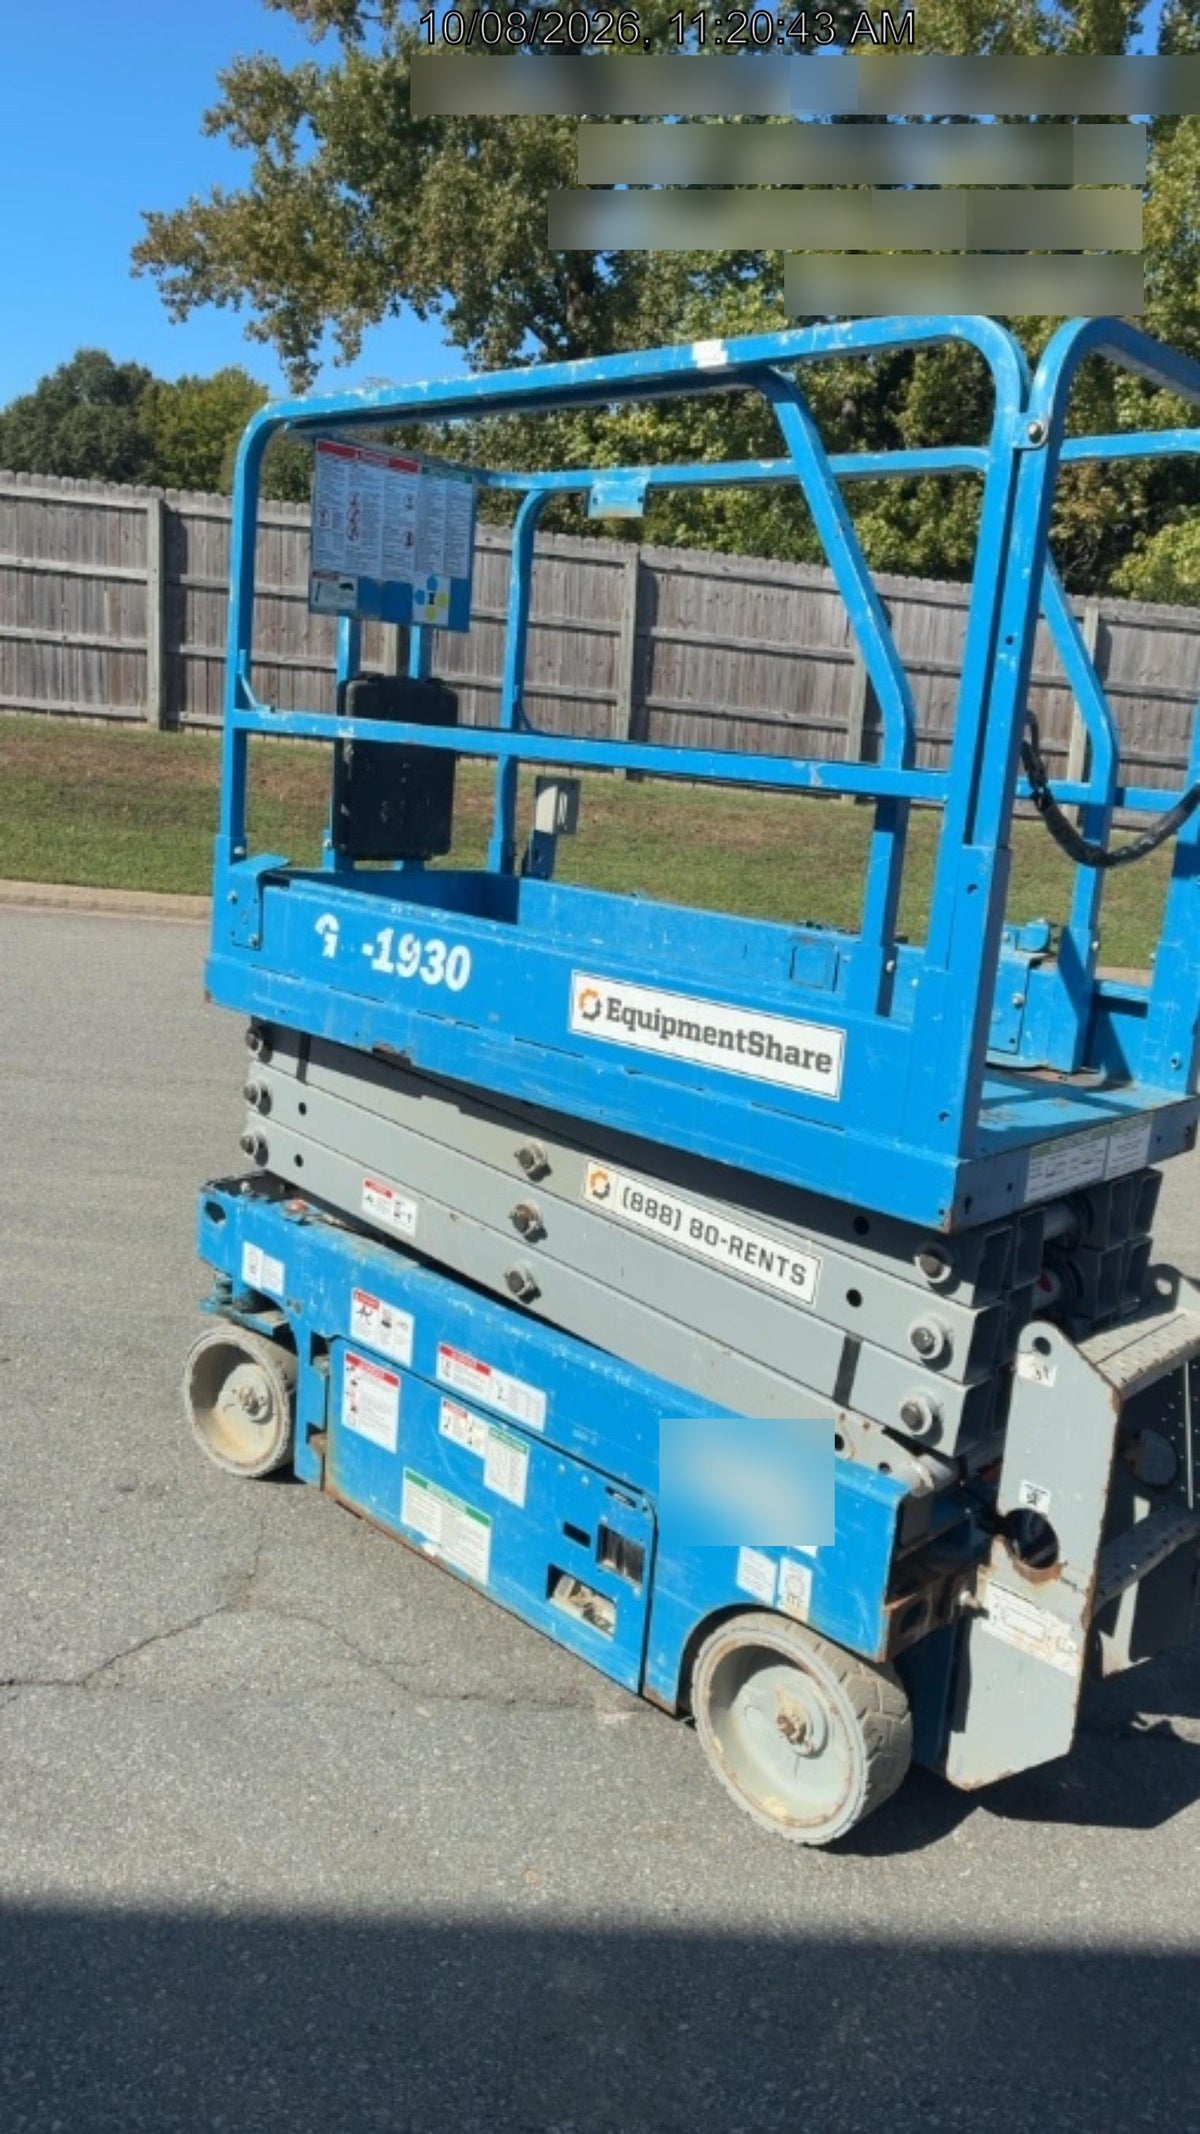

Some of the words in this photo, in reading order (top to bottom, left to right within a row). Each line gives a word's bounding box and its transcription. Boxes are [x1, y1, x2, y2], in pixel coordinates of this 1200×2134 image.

[606, 997, 832, 1074] EquipmentShare
[622, 1187, 681, 1231] (888)
[689, 1218, 806, 1286] 80-RENTS
